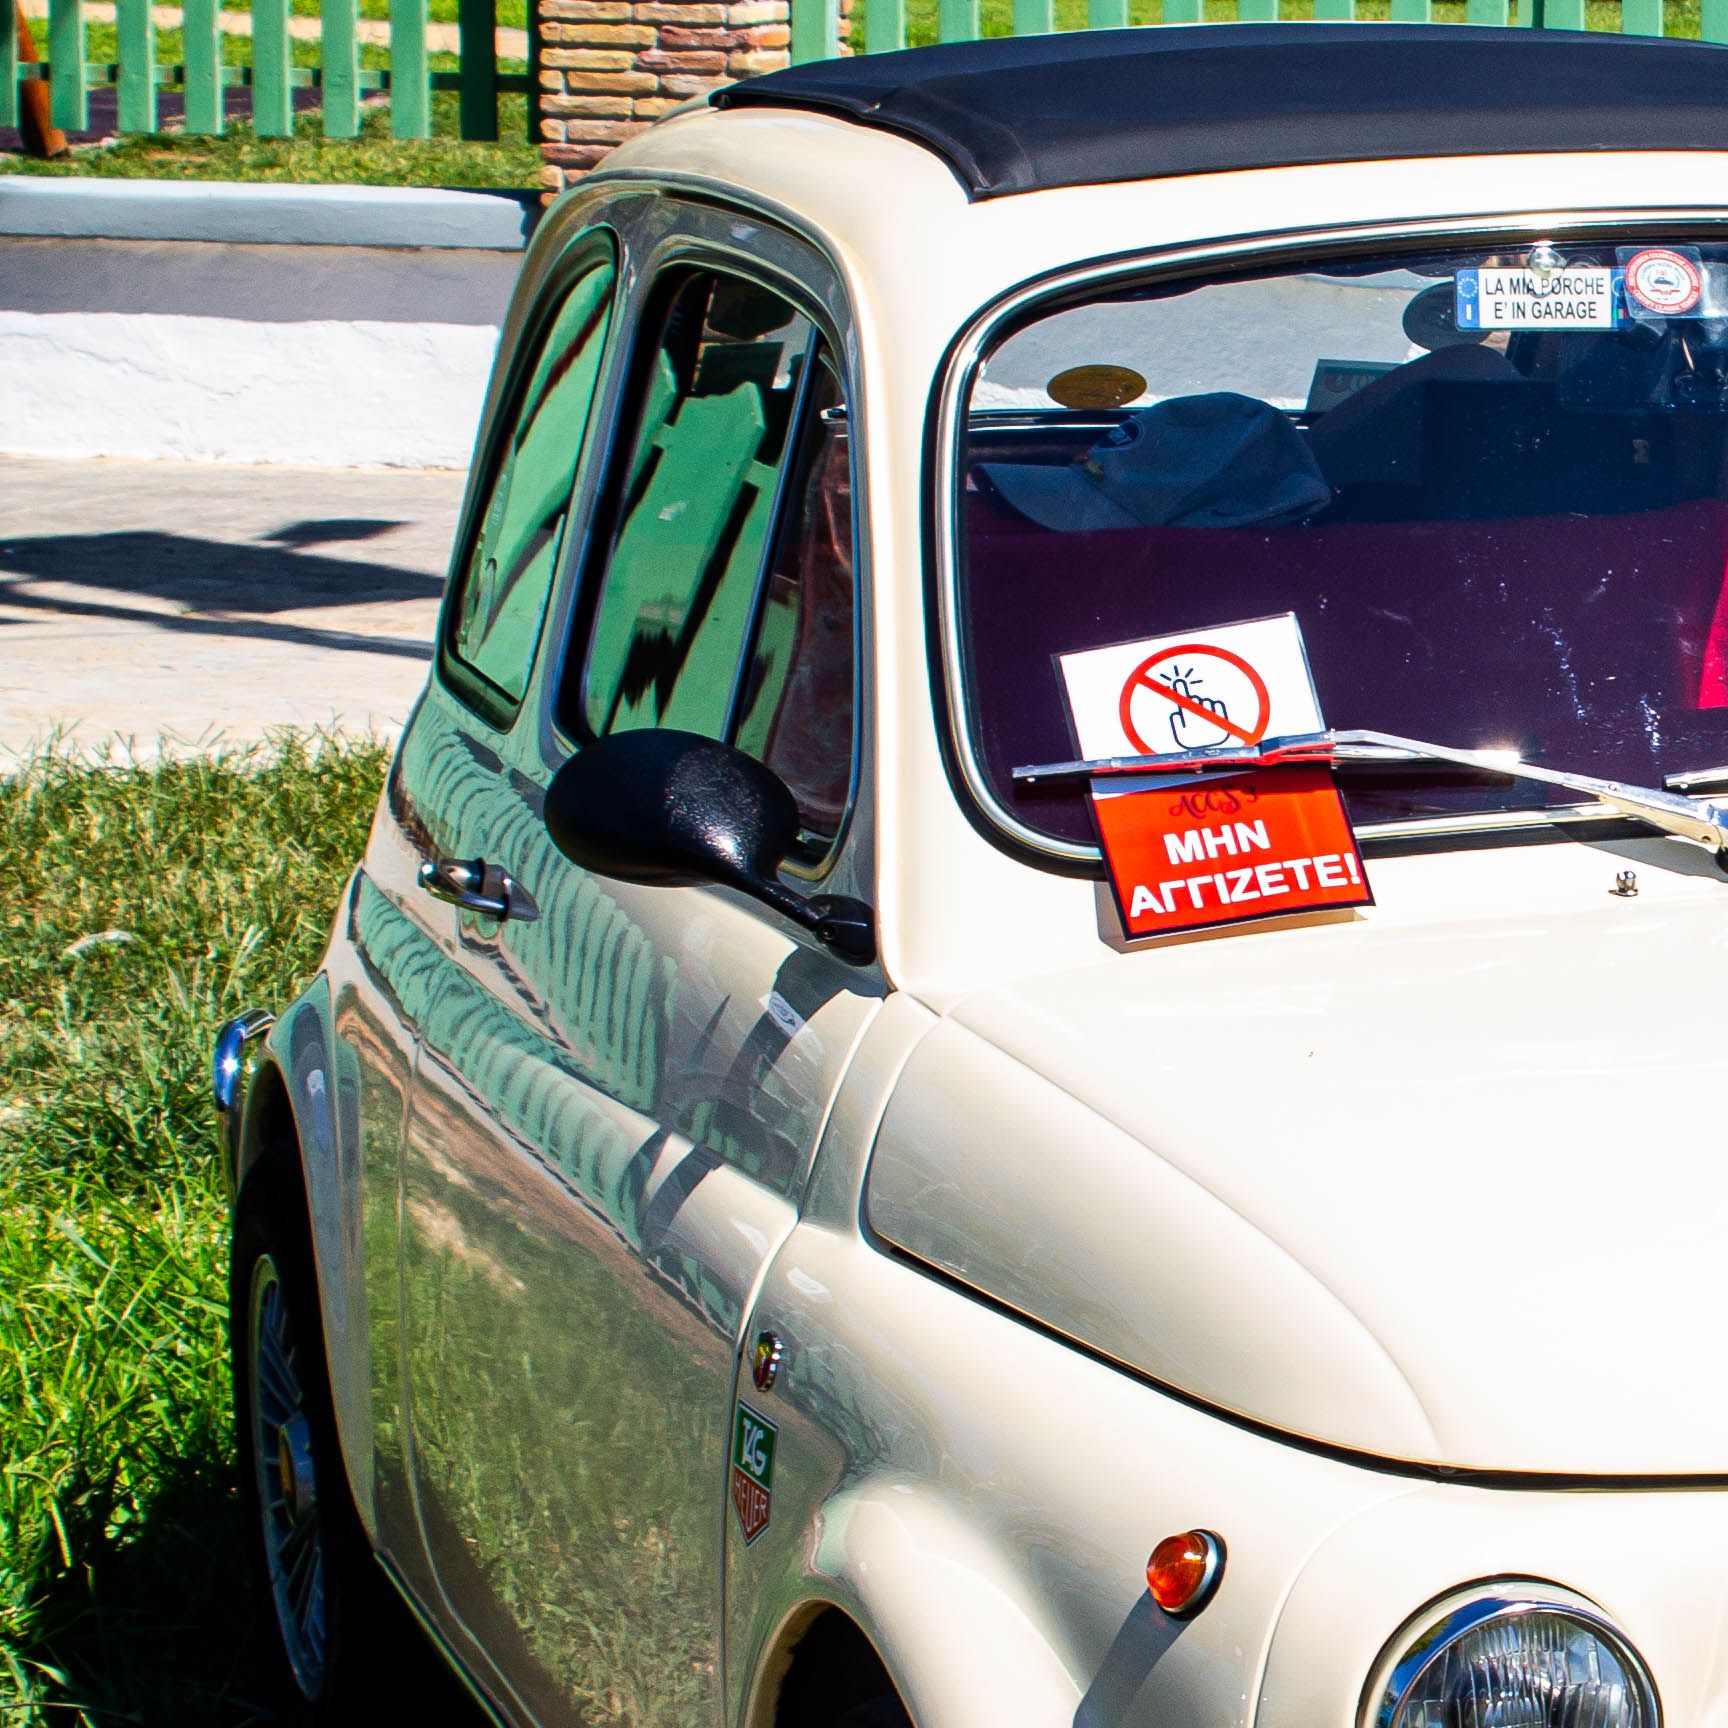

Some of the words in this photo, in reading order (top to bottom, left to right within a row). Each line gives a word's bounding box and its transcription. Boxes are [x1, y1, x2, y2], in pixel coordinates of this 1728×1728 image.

[1485, 277, 1505, 296] LA
[1509, 277, 1535, 296] MIA
[1541, 277, 1605, 296] PORCHE
[1494, 301, 1507, 319] E'
[1512, 301, 1526, 319] IN
[1531, 301, 1597, 320] GARAGE
[1163, 819, 1271, 865] ΜΗΝ
[1129, 852, 1362, 917] ΑΓΓΙΖΕΤΕ!
